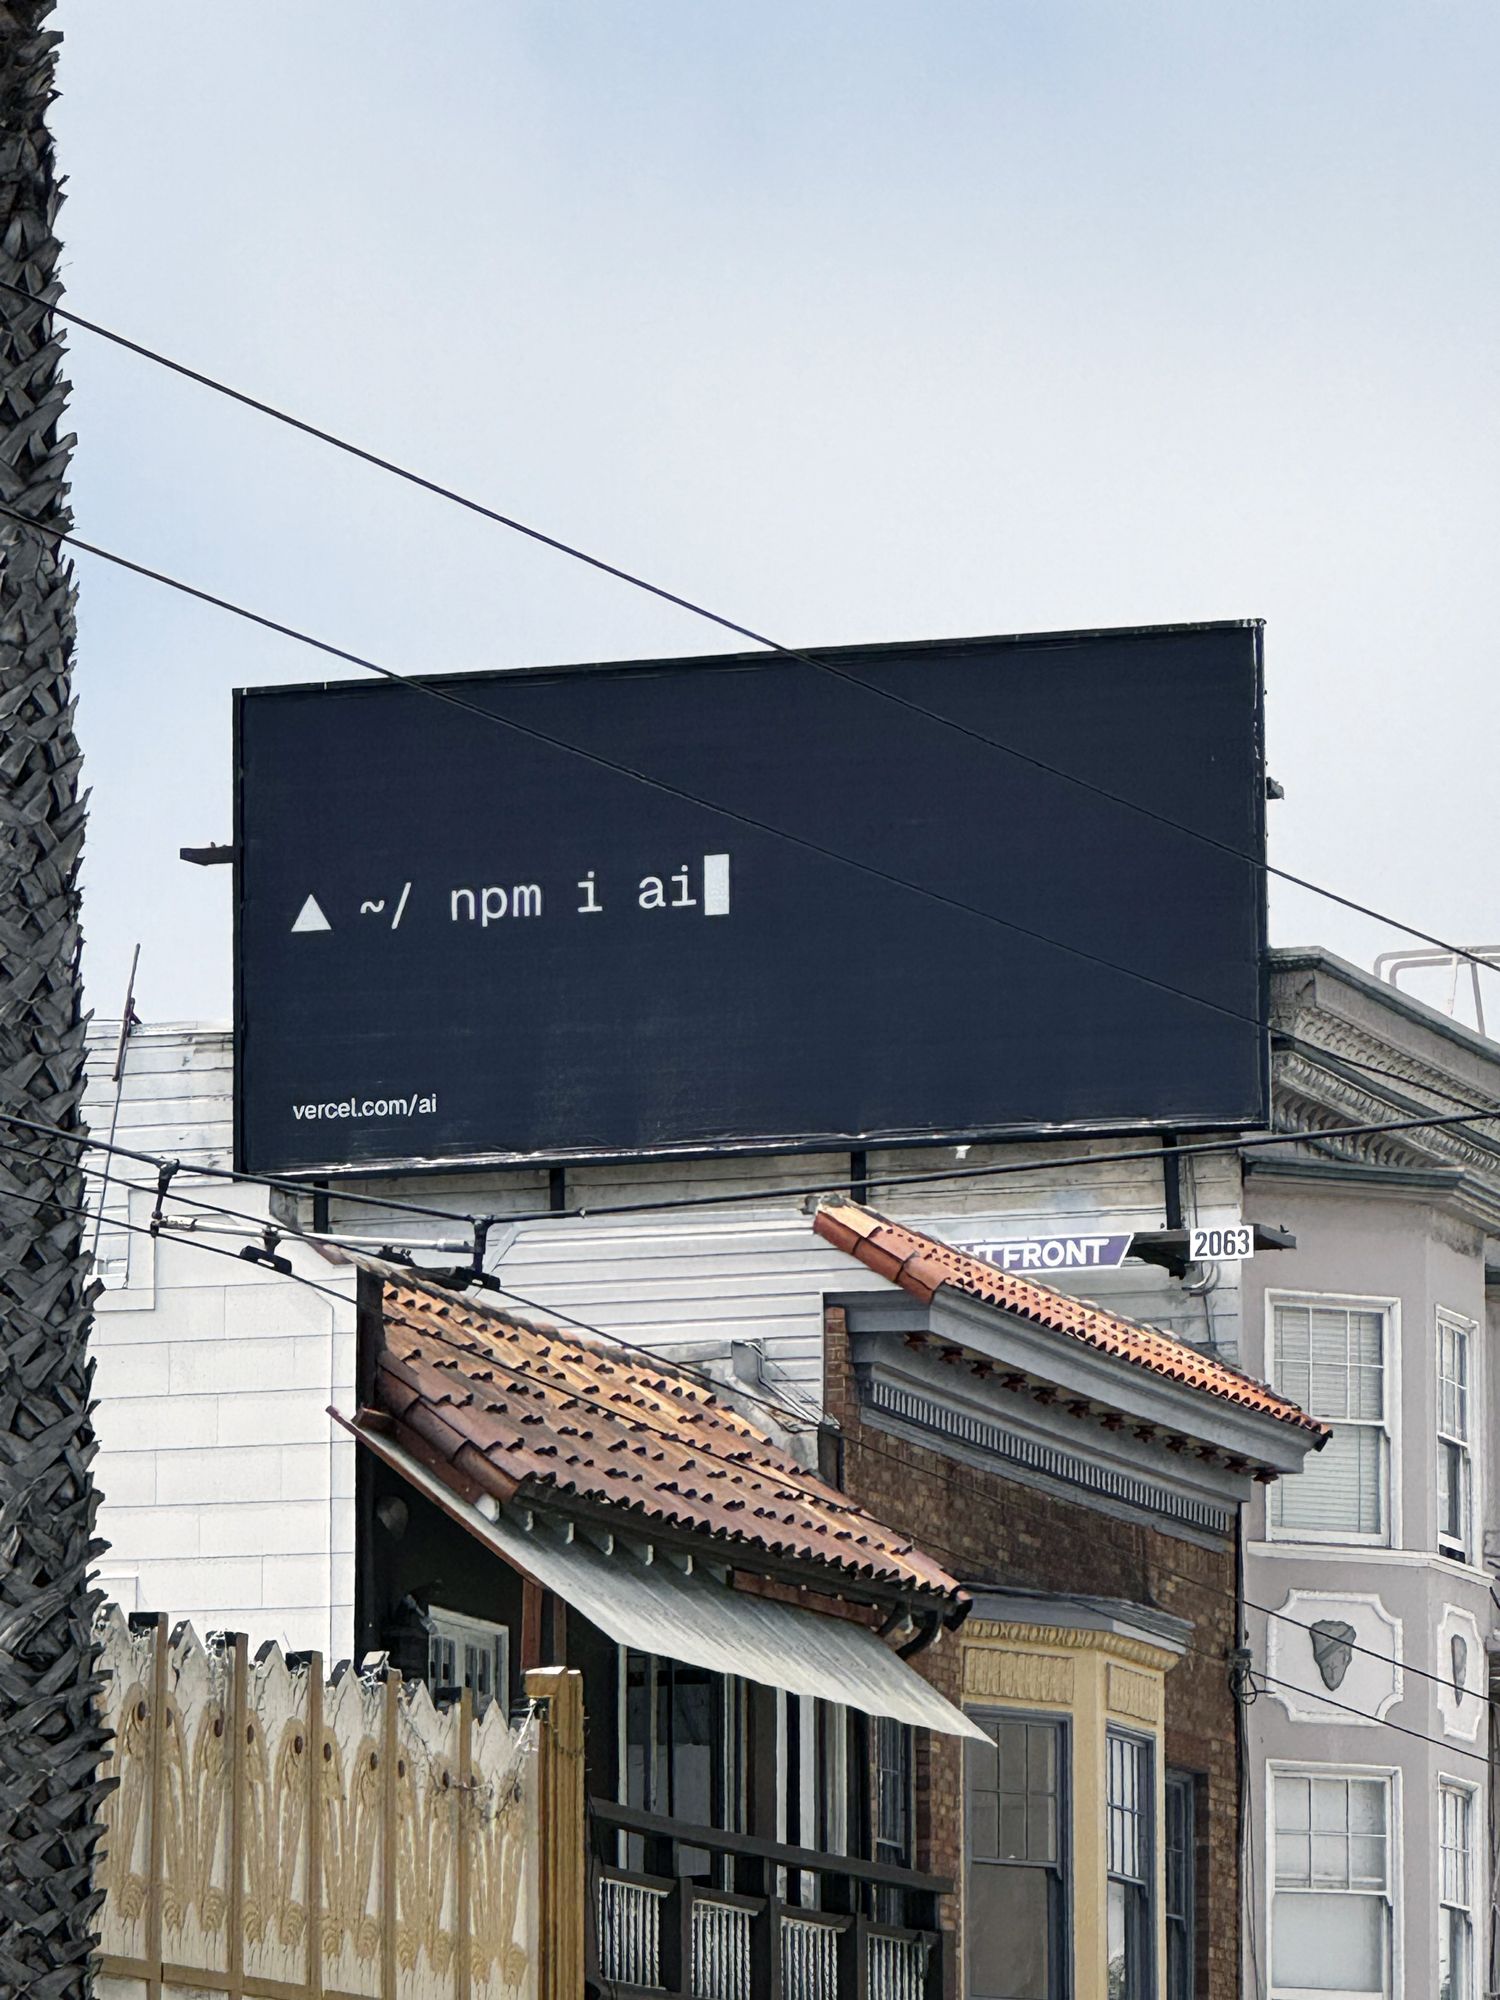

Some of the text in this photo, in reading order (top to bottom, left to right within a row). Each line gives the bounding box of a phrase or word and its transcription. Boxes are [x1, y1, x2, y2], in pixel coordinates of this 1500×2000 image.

[360, 864, 697, 930] ~/ npm i ai
[292, 1093, 437, 1120] vercel.com/ai
[1194, 1229, 1250, 1257] 2063
